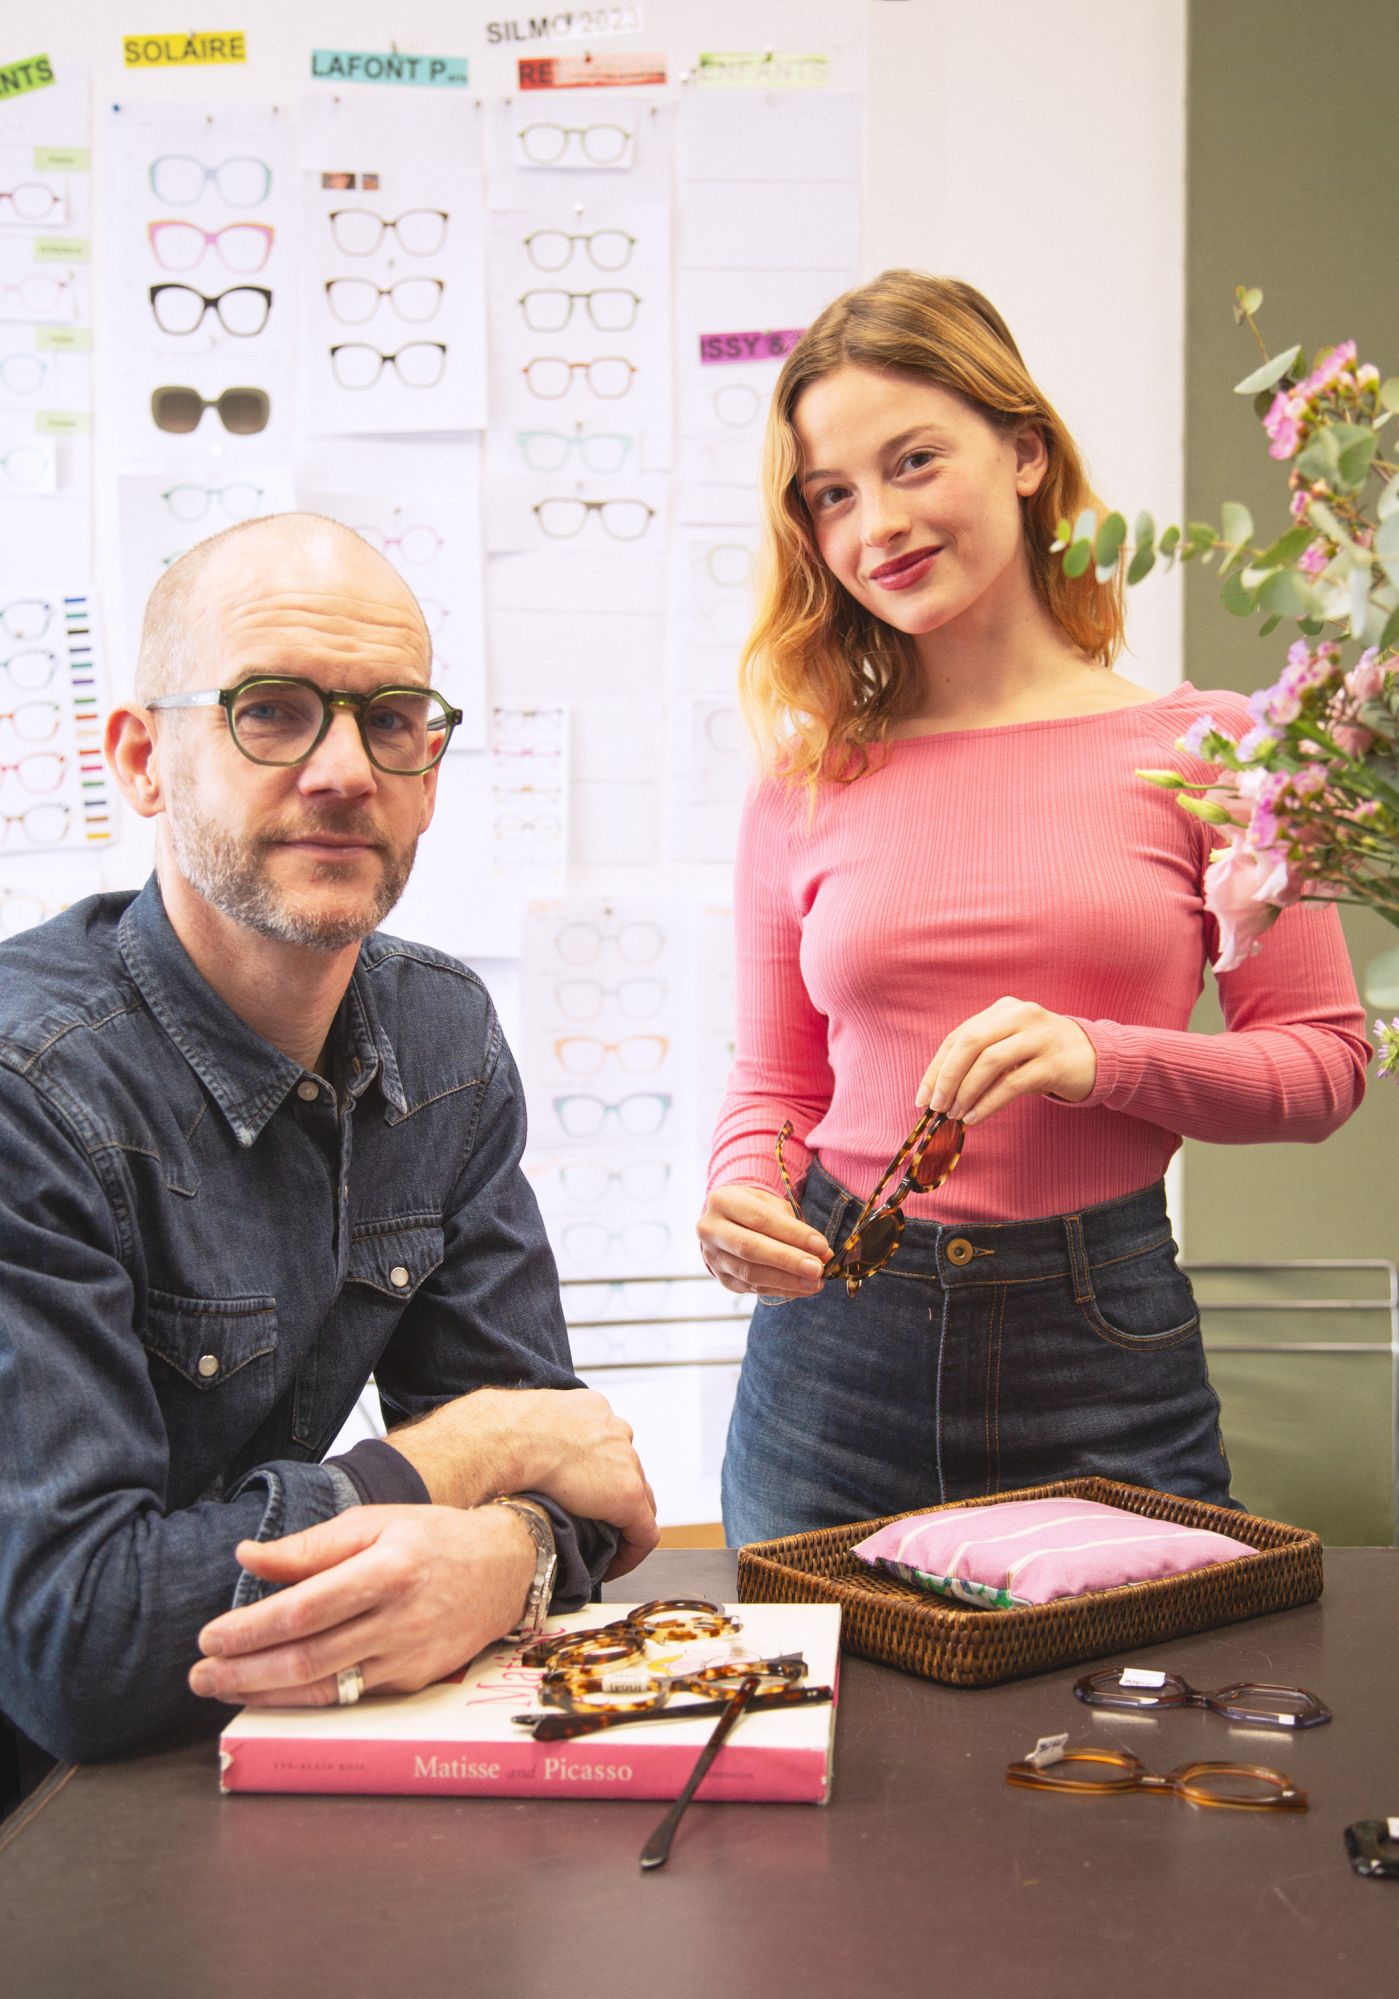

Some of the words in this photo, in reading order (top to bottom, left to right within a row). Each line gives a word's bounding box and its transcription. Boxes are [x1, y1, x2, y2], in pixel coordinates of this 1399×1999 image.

[486, 12, 572, 44] SILMO
[579, 7, 640, 33] 2023
[125, 36, 244, 63] SOLAIRE
[0, 58, 54, 96] NTS
[311, 53, 421, 79] LAFONT
[700, 335, 760, 359] ISSY
[413, 1756, 501, 1779] Matisse
[506, 1763, 537, 1781] and
[543, 1757, 634, 1782] Picasso
